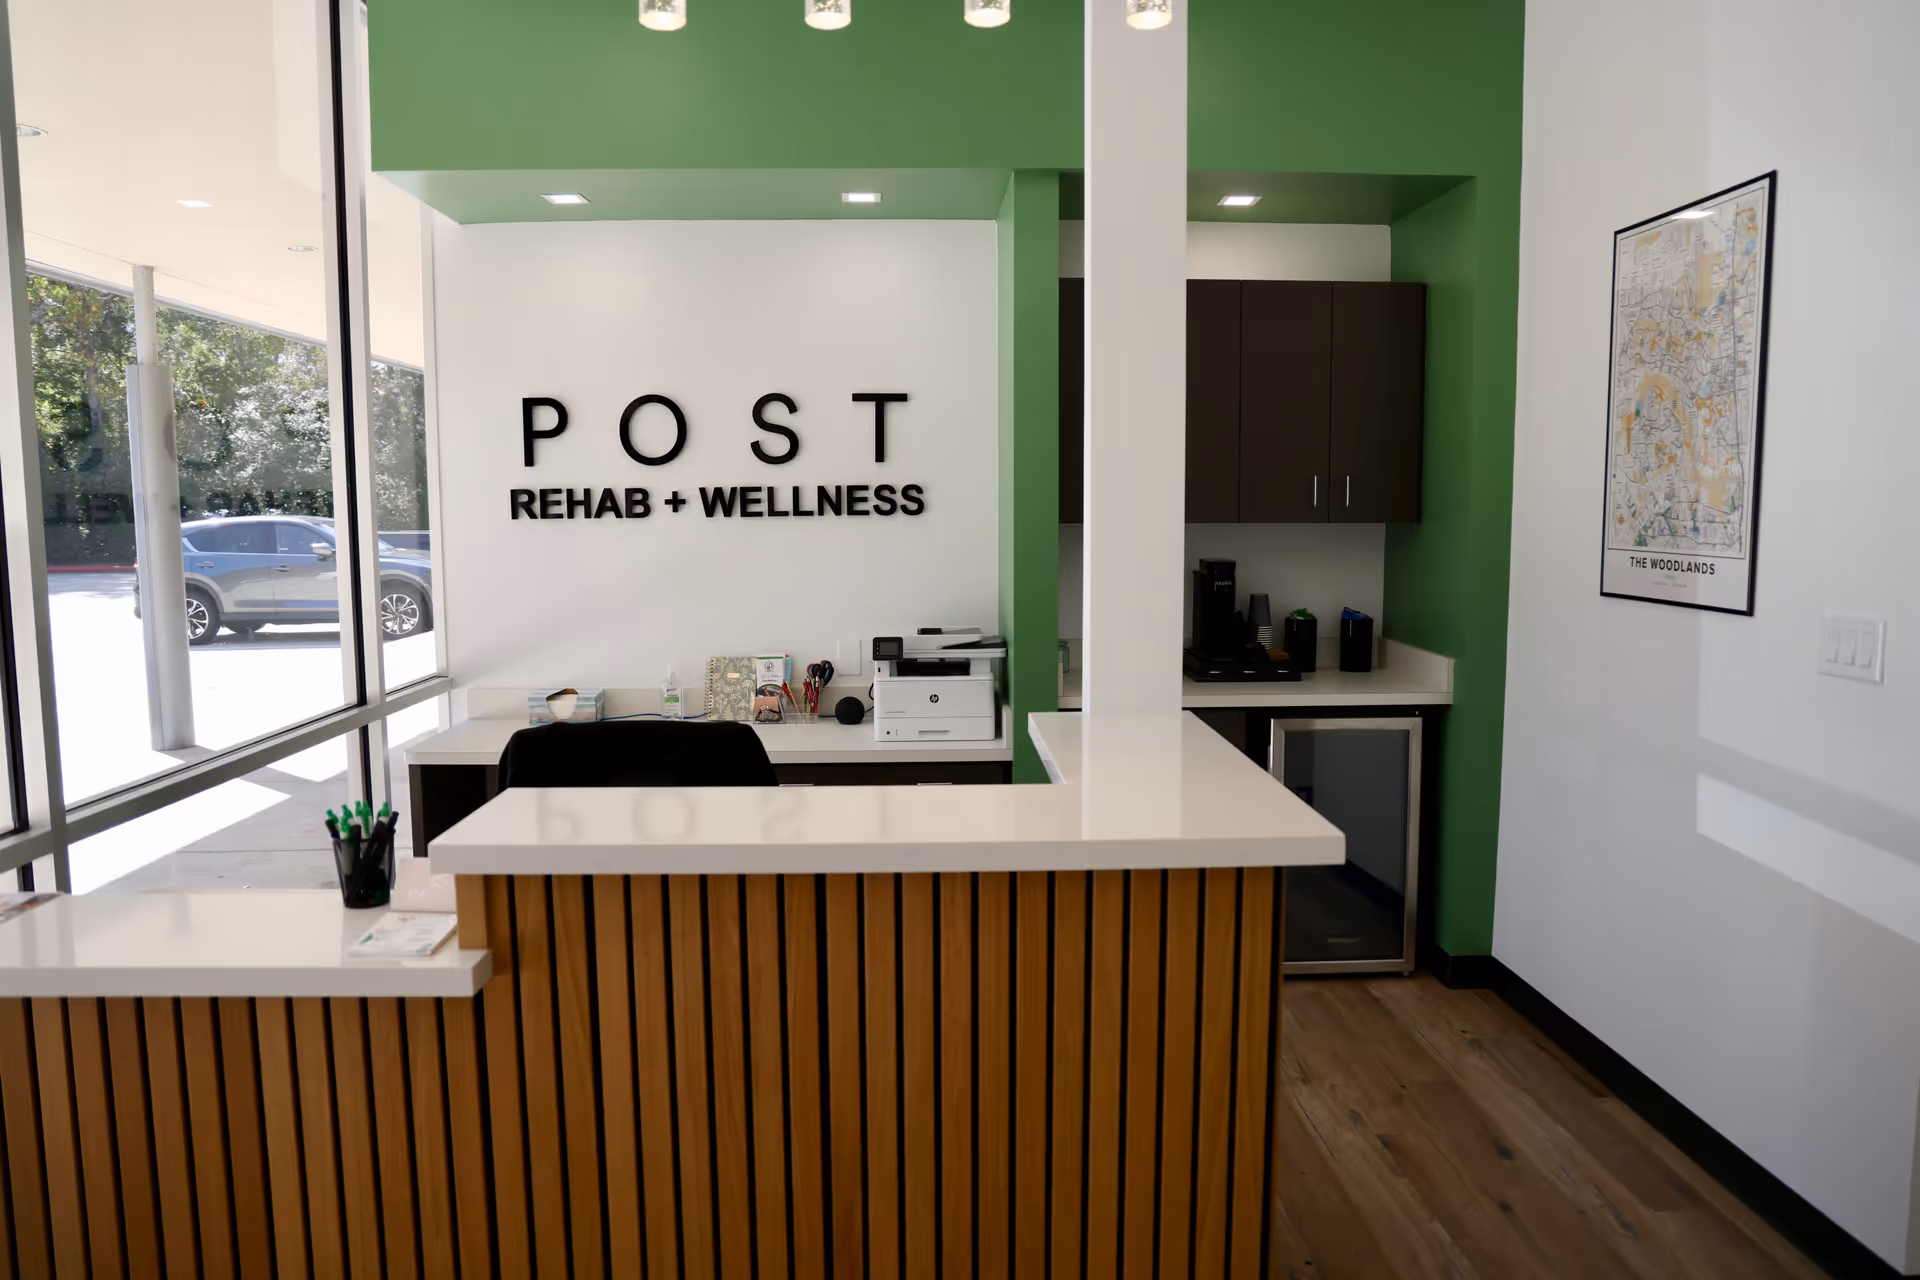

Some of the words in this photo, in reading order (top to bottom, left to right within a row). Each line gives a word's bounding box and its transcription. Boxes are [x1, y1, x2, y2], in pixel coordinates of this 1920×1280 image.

[521, 393, 908, 467] POST
[510, 487, 652, 520] REHAB
[664, 490, 687, 513] +
[699, 484, 925, 518] WELLNESS
[1630, 556, 1647, 568] THE
[1650, 558, 1715, 575] WOODLANDS
